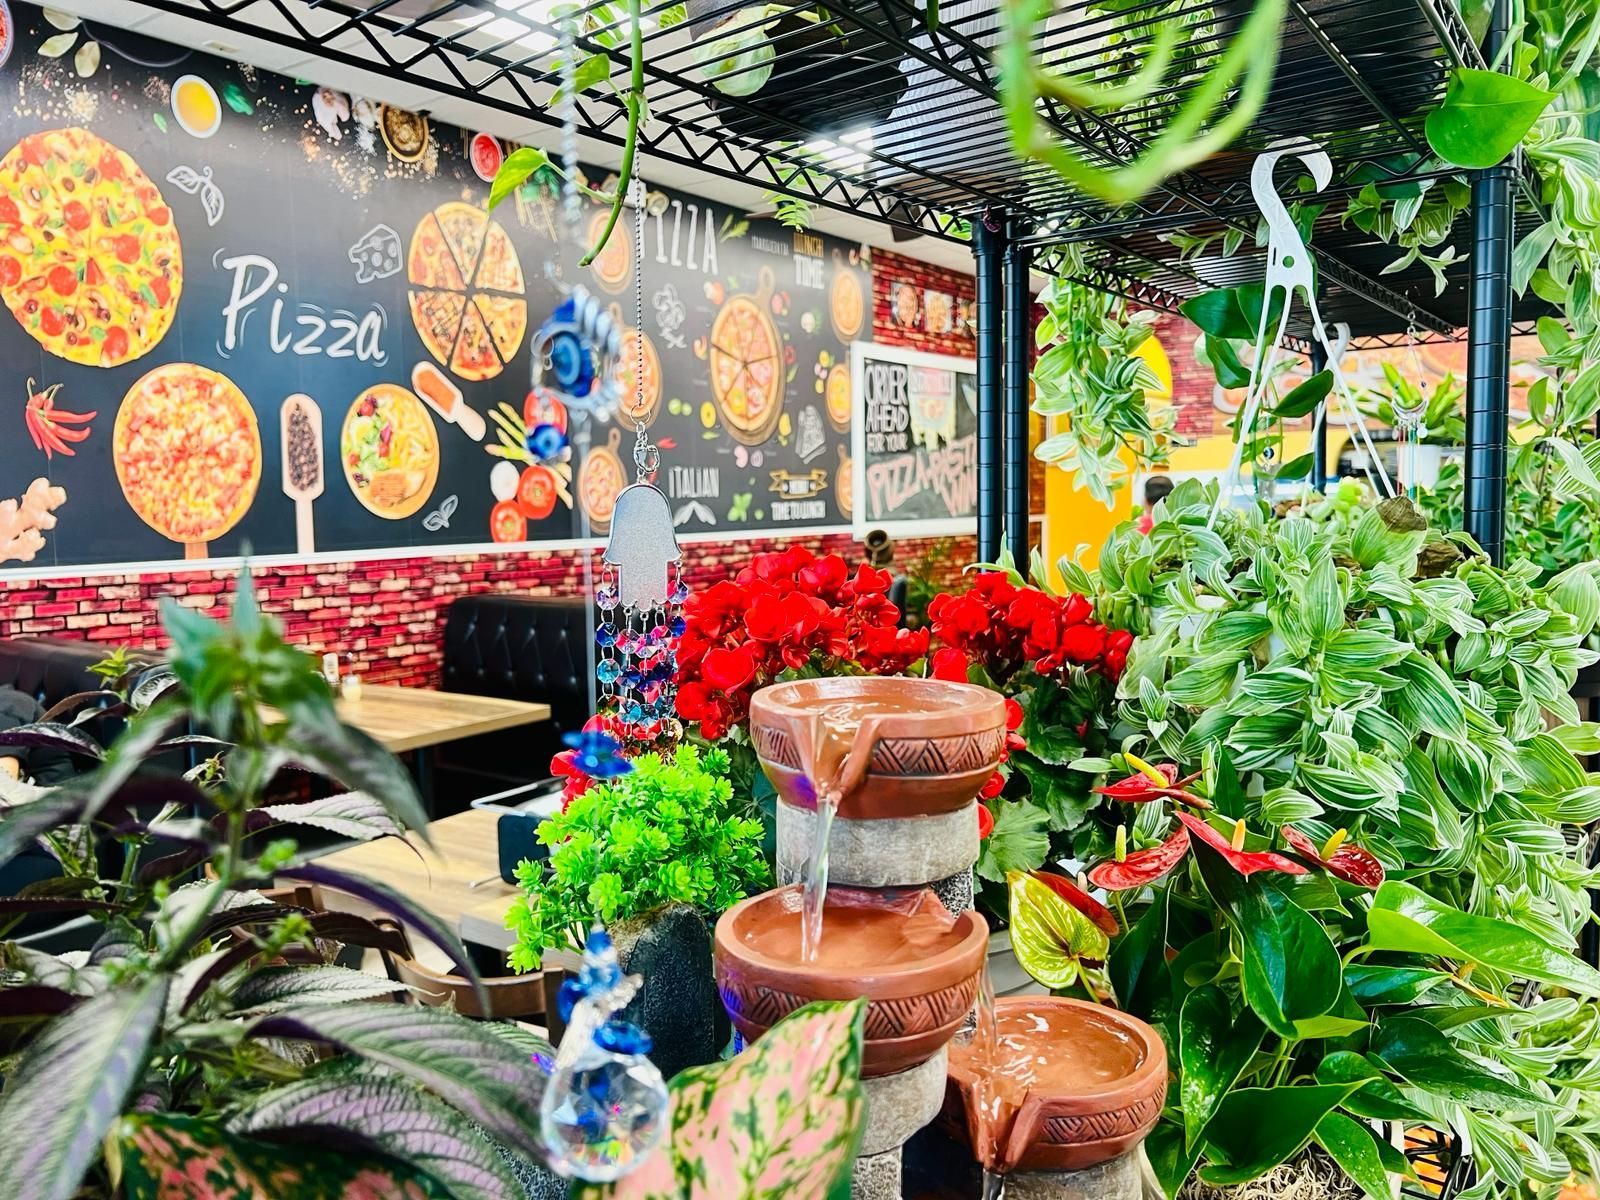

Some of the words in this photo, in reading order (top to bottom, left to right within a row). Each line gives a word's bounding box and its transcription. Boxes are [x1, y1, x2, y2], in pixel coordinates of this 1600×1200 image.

[793, 254, 825, 290] TIME
[222, 254, 386, 362] Pizza
[864, 364, 909, 405] ORDER
[865, 402, 910, 432] AHEAD
[866, 431, 886, 451] FOR
[668, 466, 719, 499] ITALIAN
